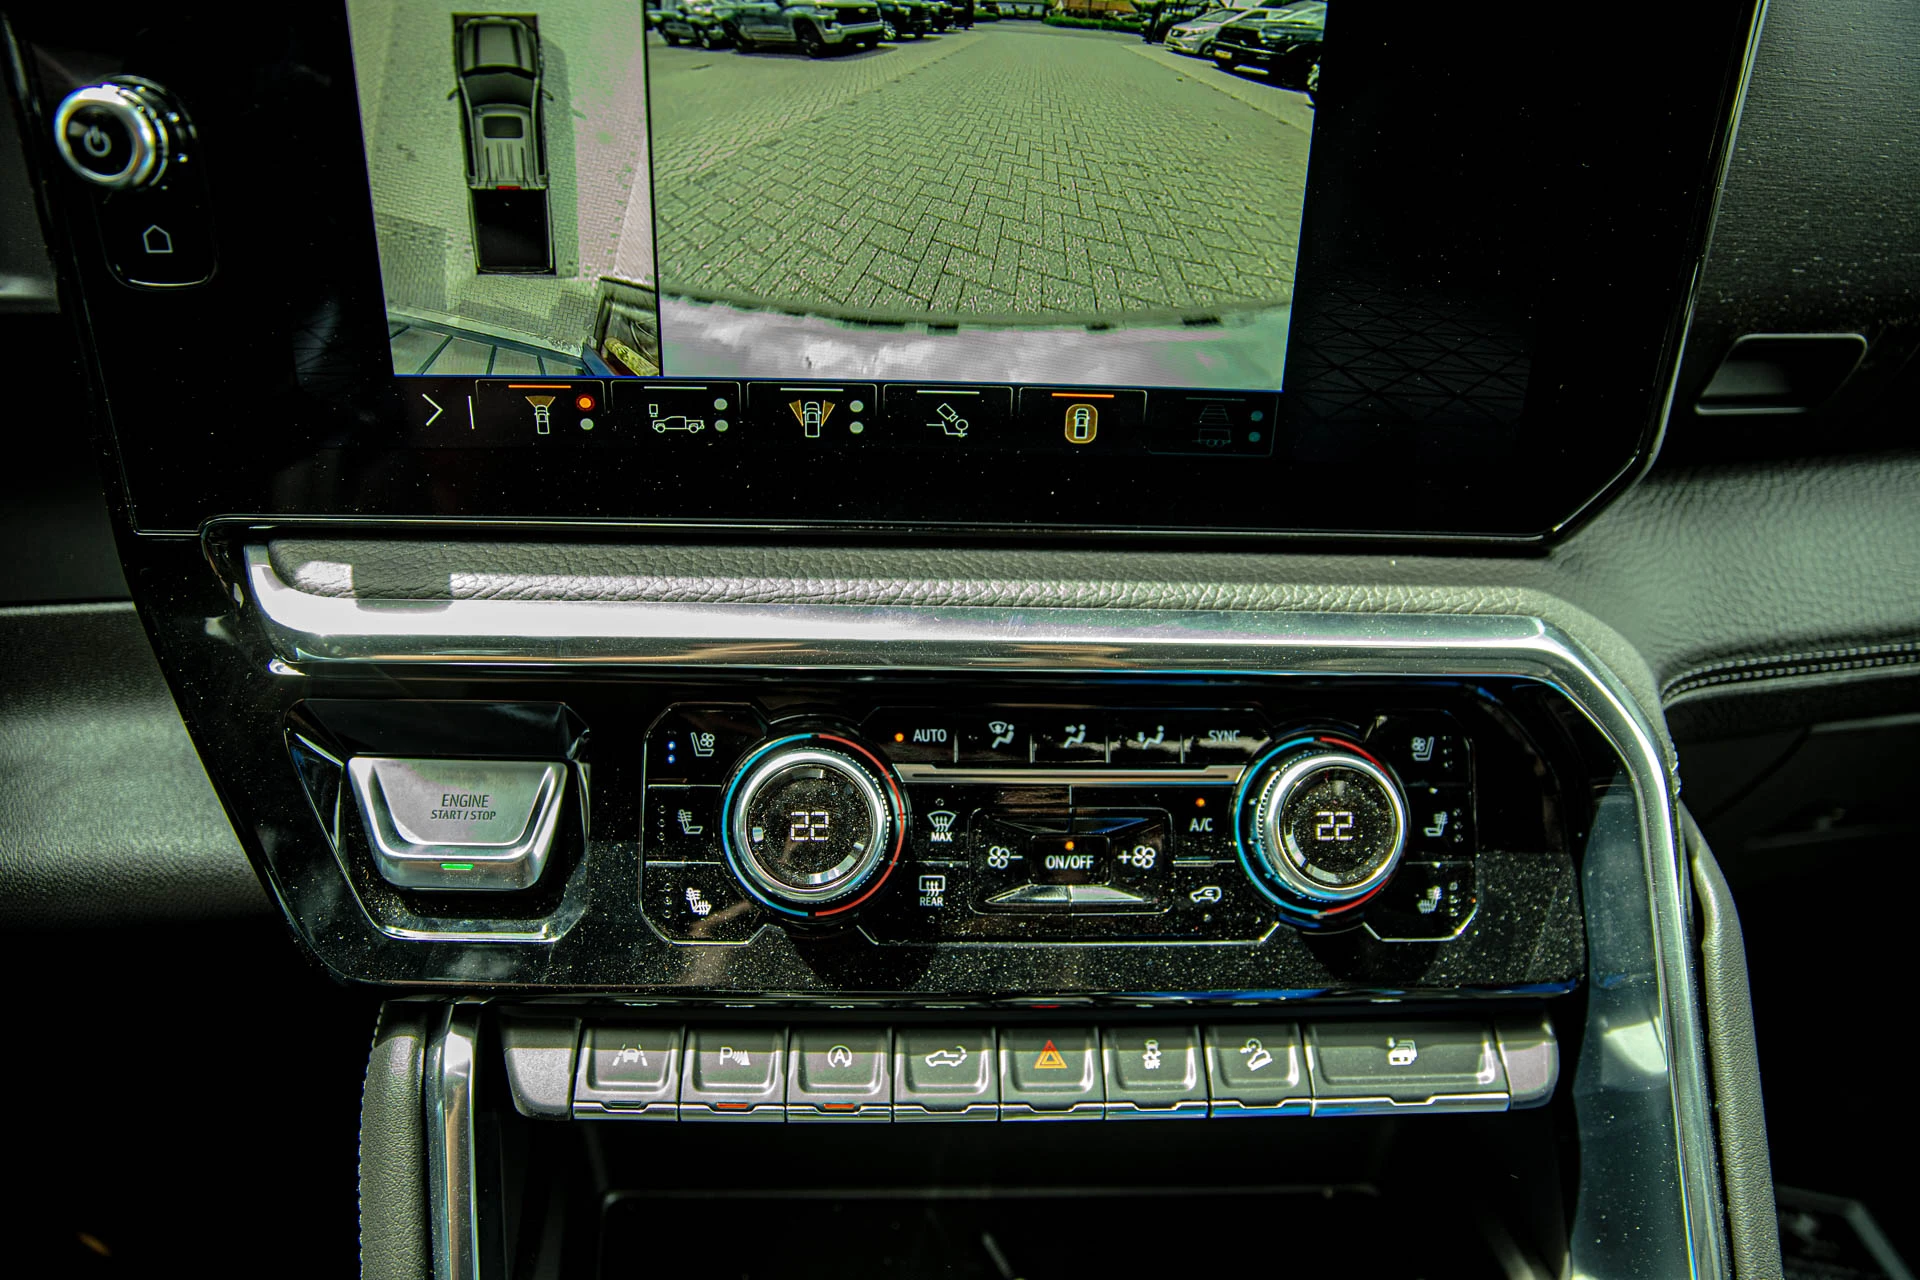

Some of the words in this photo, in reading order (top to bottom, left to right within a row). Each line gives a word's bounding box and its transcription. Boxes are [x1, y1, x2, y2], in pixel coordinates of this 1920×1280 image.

[912, 728, 947, 743] AUTO
[1208, 729, 1240, 743] SYNC
[441, 794, 489, 808] ENGINE
[430, 810, 463, 820] START
[470, 810, 496, 820] STOP
[790, 811, 829, 841] 22
[1189, 817, 1214, 832] A/C
[1315, 811, 1354, 841] 22
[930, 831, 952, 842] MAX
[1045, 855, 1094, 870] ON/OFF
[919, 896, 944, 907] REAR
[1144, 1059, 1161, 1070] OFF
